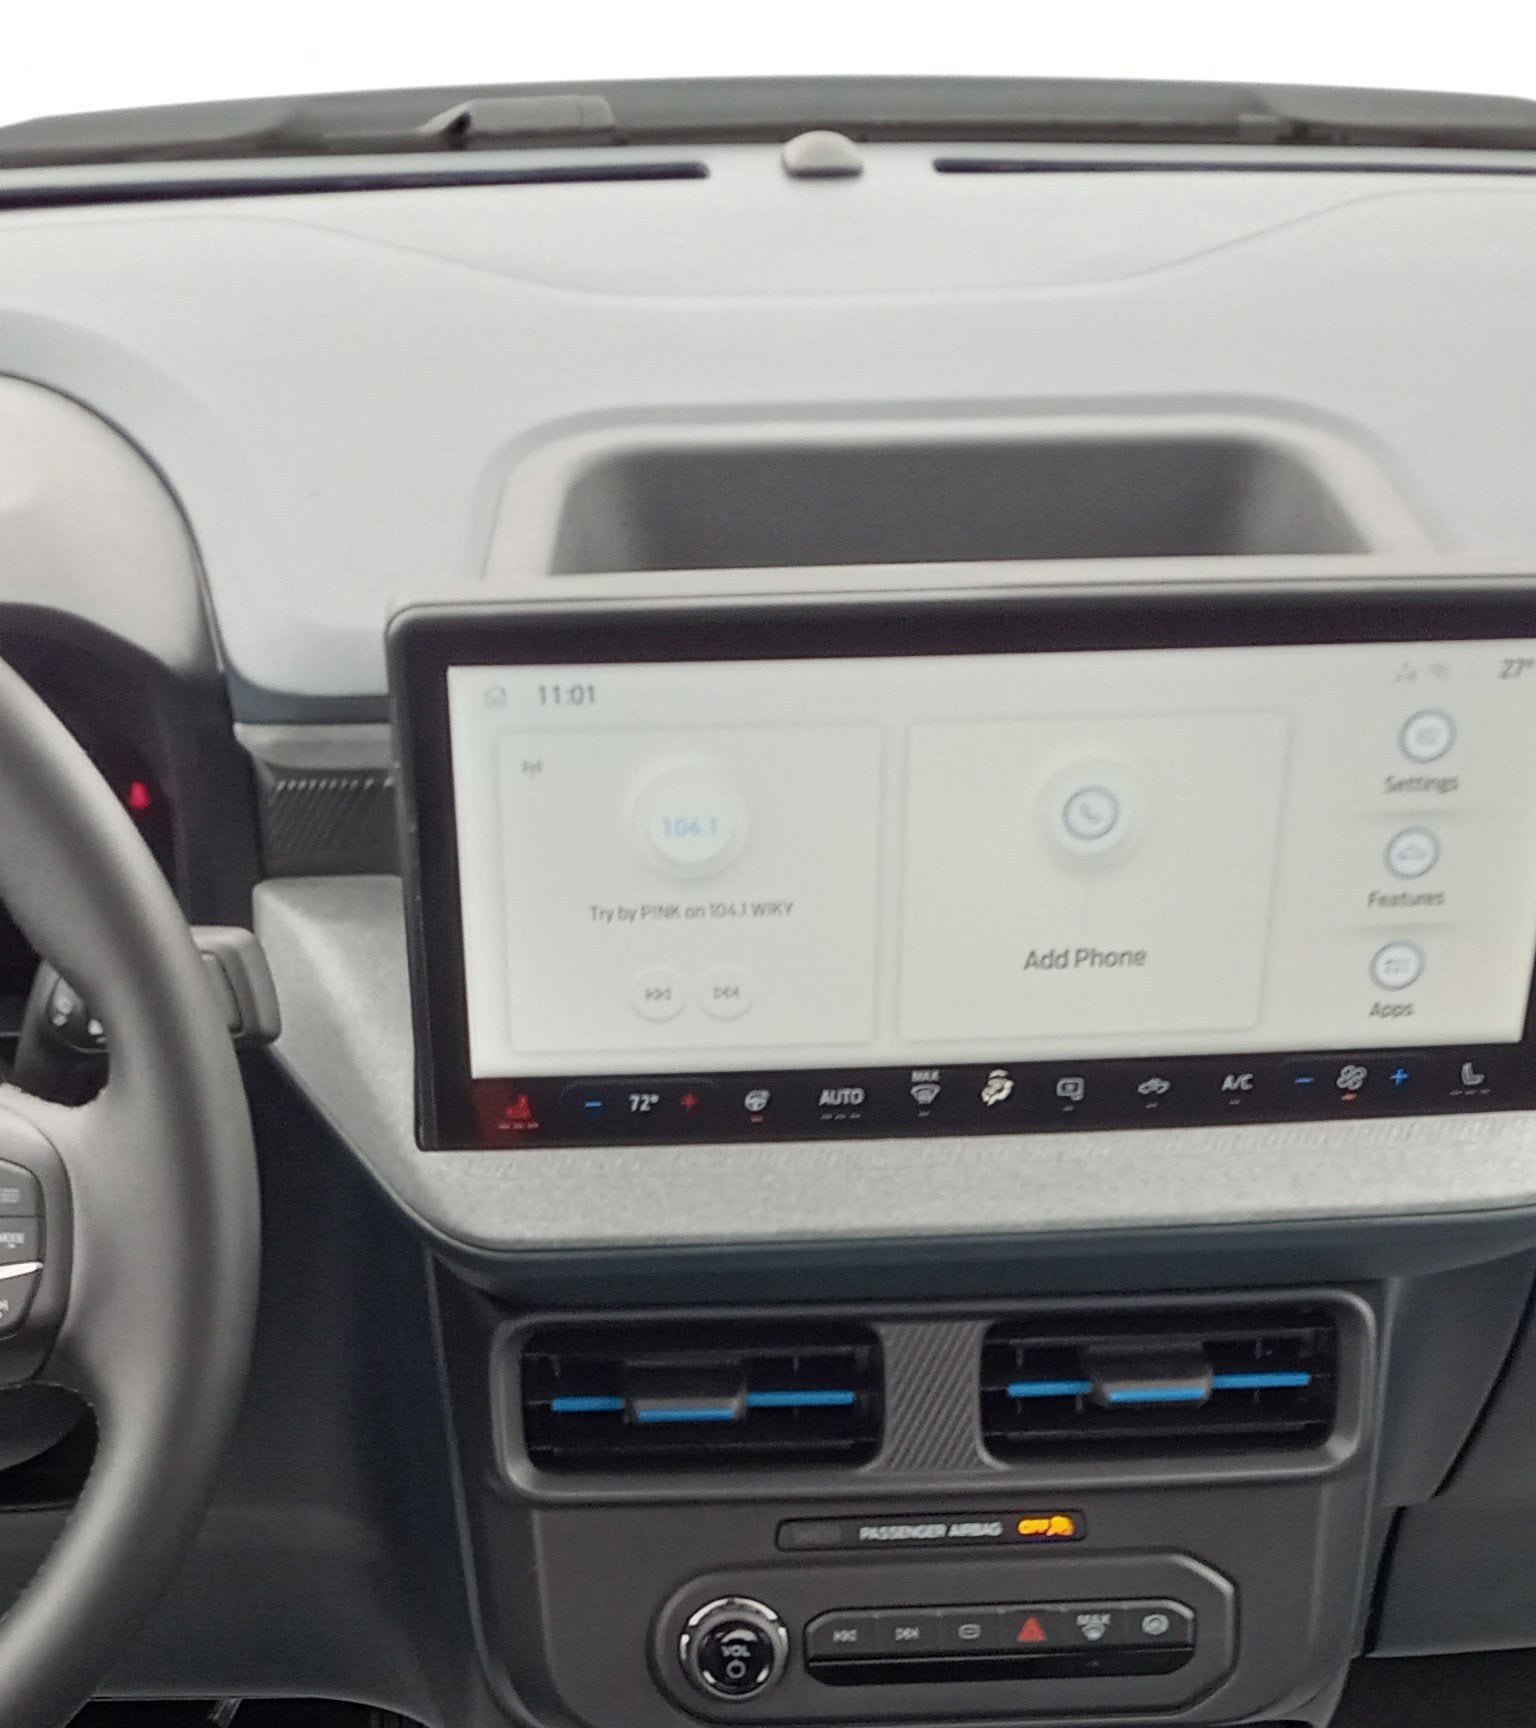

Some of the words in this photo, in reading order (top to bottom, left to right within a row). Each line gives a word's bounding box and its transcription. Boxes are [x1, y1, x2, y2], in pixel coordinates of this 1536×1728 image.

[538, 685, 596, 705] 11:01
[1385, 774, 1459, 796] Settings
[661, 816, 719, 838] 104.1
[1368, 889, 1445, 909] Features
[591, 904, 614, 924] Try
[617, 903, 637, 923] by
[684, 906, 705, 919] on
[1023, 948, 1068, 970] Add
[1074, 946, 1147, 968] Phone
[1369, 1001, 1415, 1020] Apps
[910, 1069, 940, 1083] MAX
[1222, 1073, 1254, 1093] A/C
[629, 1093, 659, 1112] 72°
[818, 1087, 864, 1106] AUTO
[858, 1523, 948, 1541] PASSENGER
[948, 1521, 1004, 1537] AIRBAG
[720, 1644, 752, 1658] VOL
